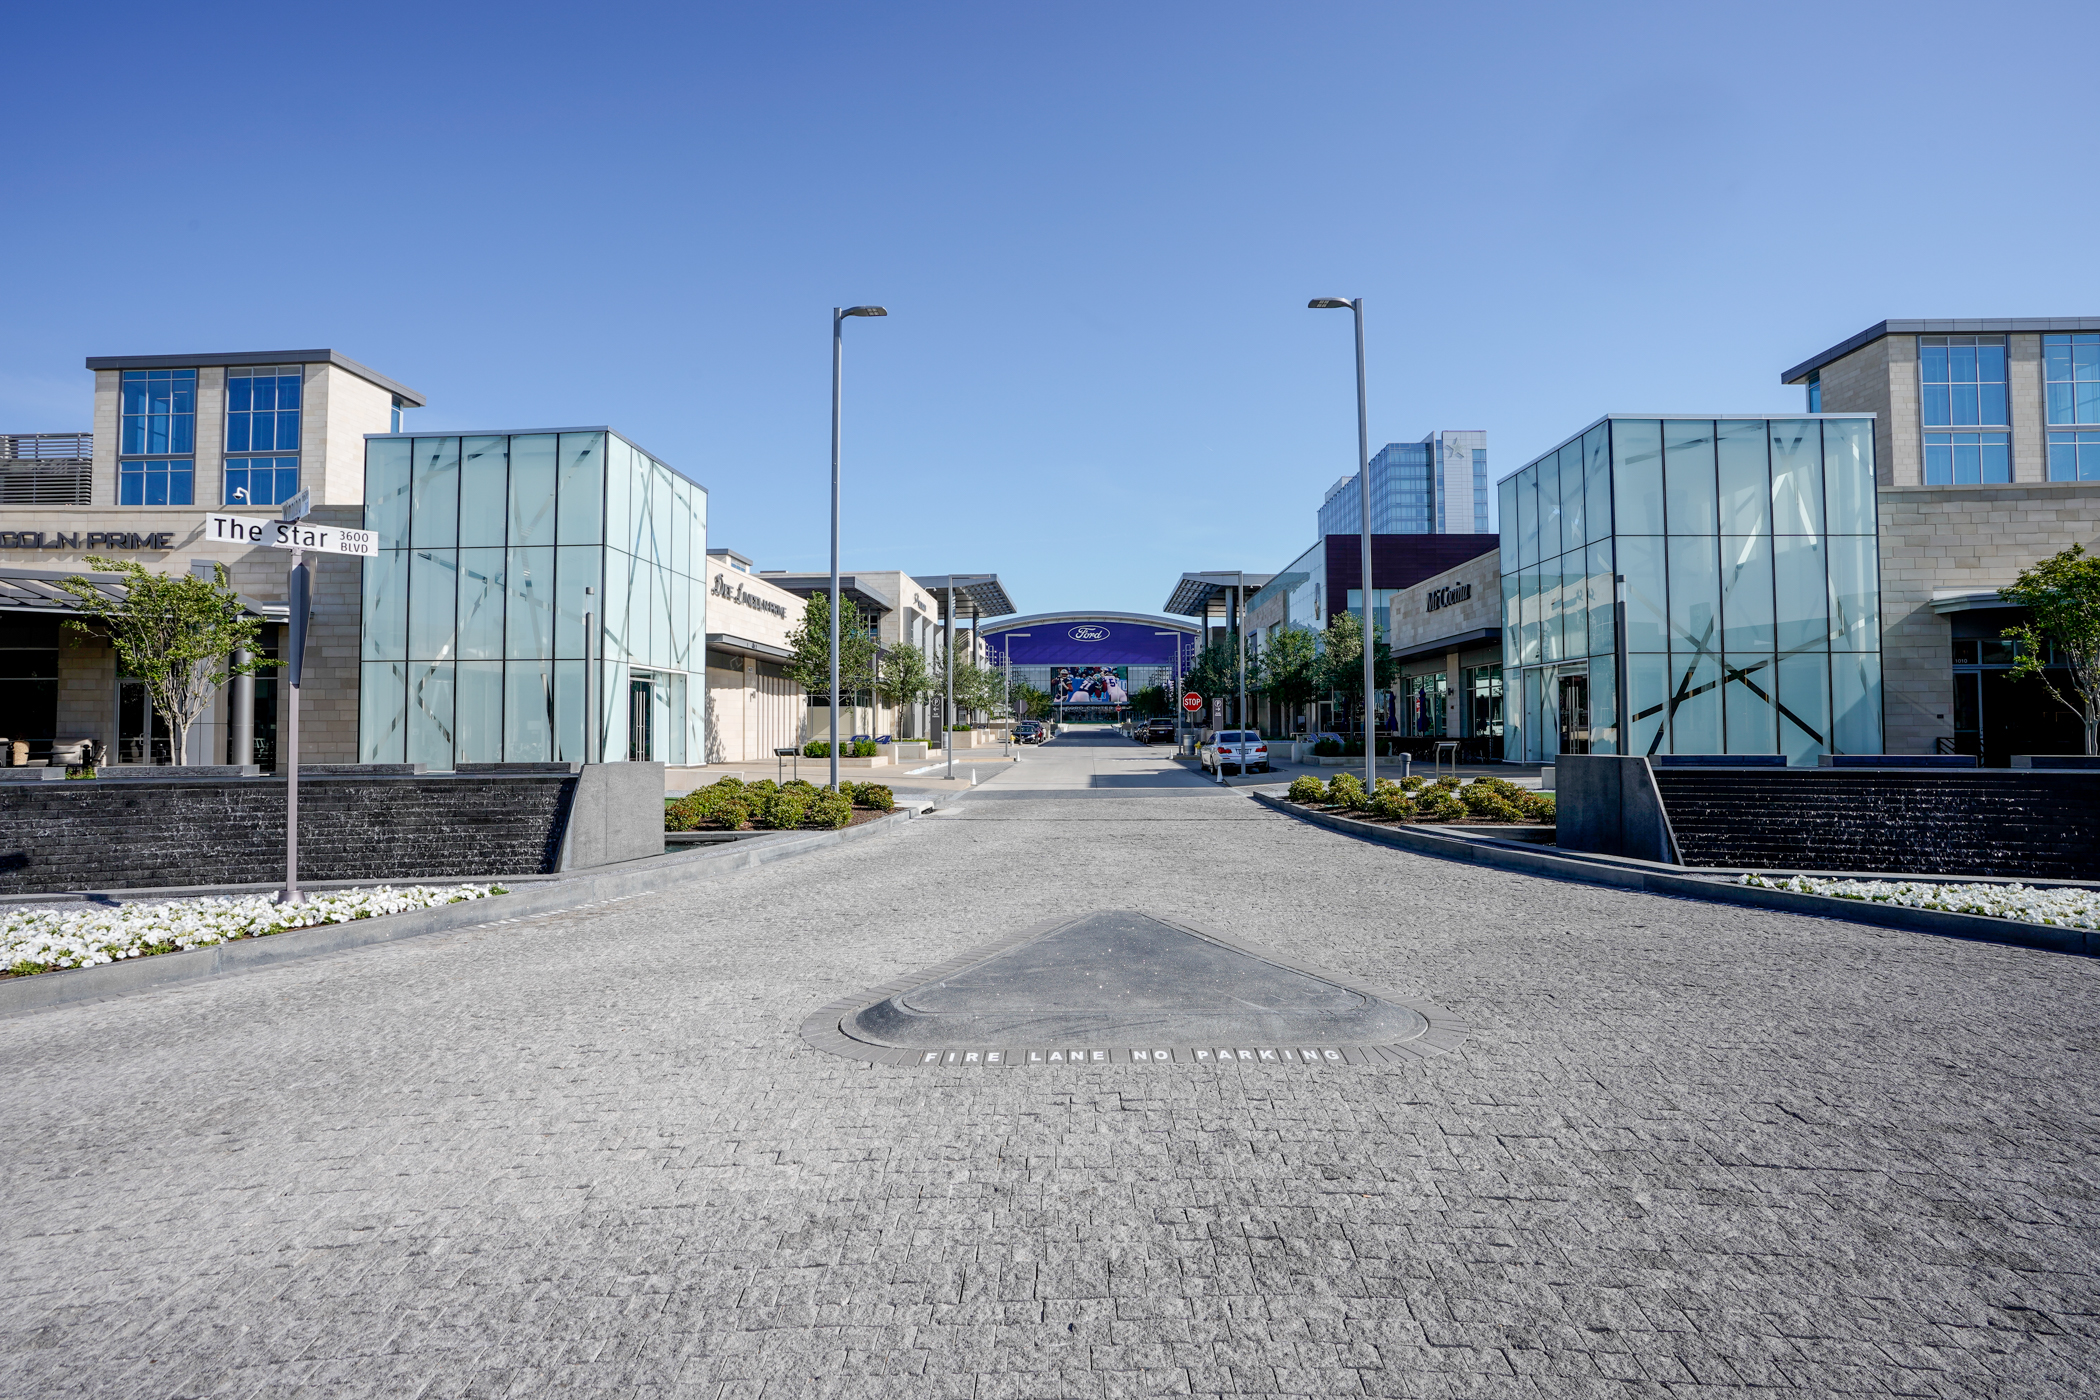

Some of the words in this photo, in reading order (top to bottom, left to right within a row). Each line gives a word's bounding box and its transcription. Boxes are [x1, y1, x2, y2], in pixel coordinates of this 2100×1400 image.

[214, 518, 263, 542] The
[276, 524, 328, 548] Star
[339, 530, 370, 543] 3600
[86, 532, 176, 550] PRIME
[340, 542, 369, 554] BLVD
[1426, 589, 1441, 613] Mi
[1440, 581, 1472, 608] Cocina
[1075, 627, 1103, 639] Ford
[1184, 698, 1201, 706] STOP
[924, 1052, 1000, 1062] FIRE
[1030, 1051, 1105, 1062] LANE
[1133, 1050, 1168, 1060] NO
[1197, 1050, 1340, 1060] PARKING
